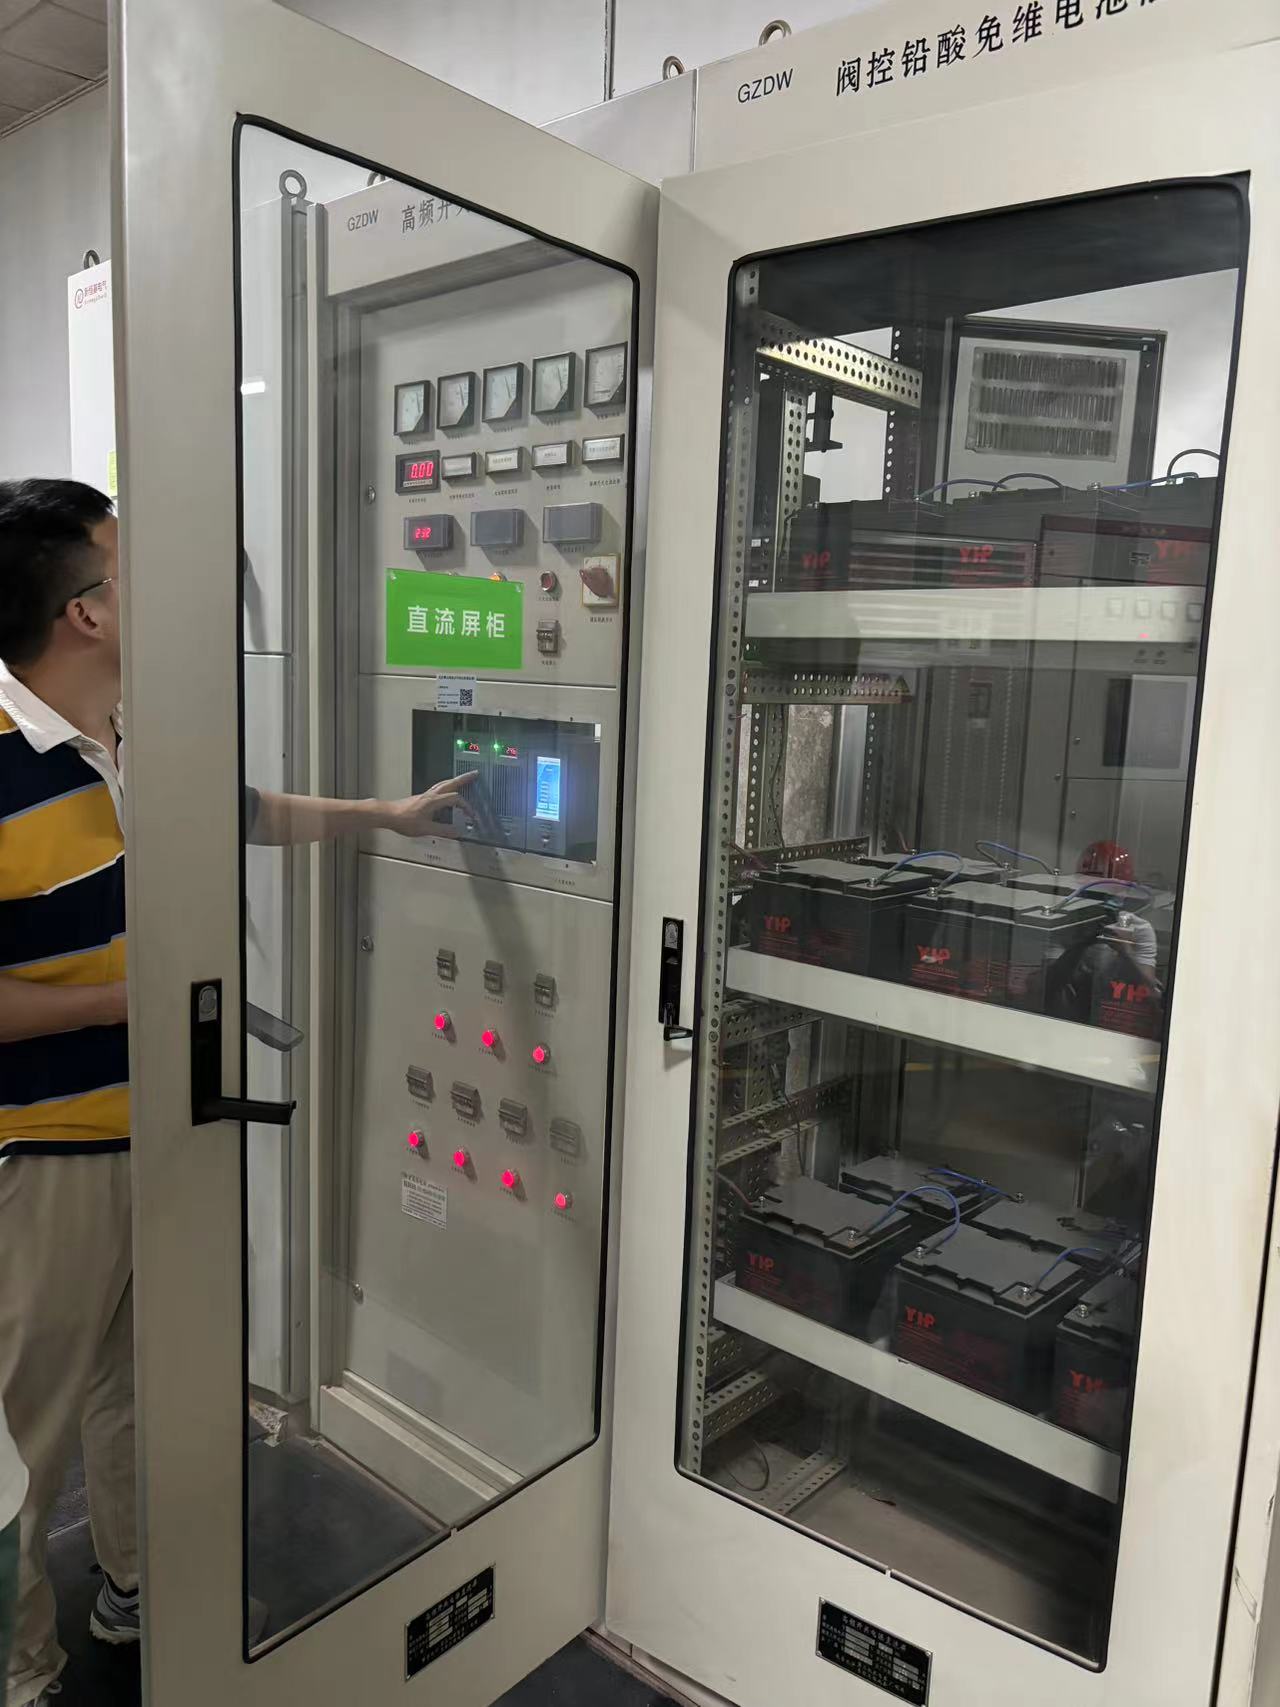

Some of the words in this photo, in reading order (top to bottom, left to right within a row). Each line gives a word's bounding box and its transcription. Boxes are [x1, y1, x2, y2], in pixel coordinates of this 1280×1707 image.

[737, 68, 794, 104] GZDW
[347, 208, 379, 232] GZDW
[406, 605, 506, 639] 直流屏柜
